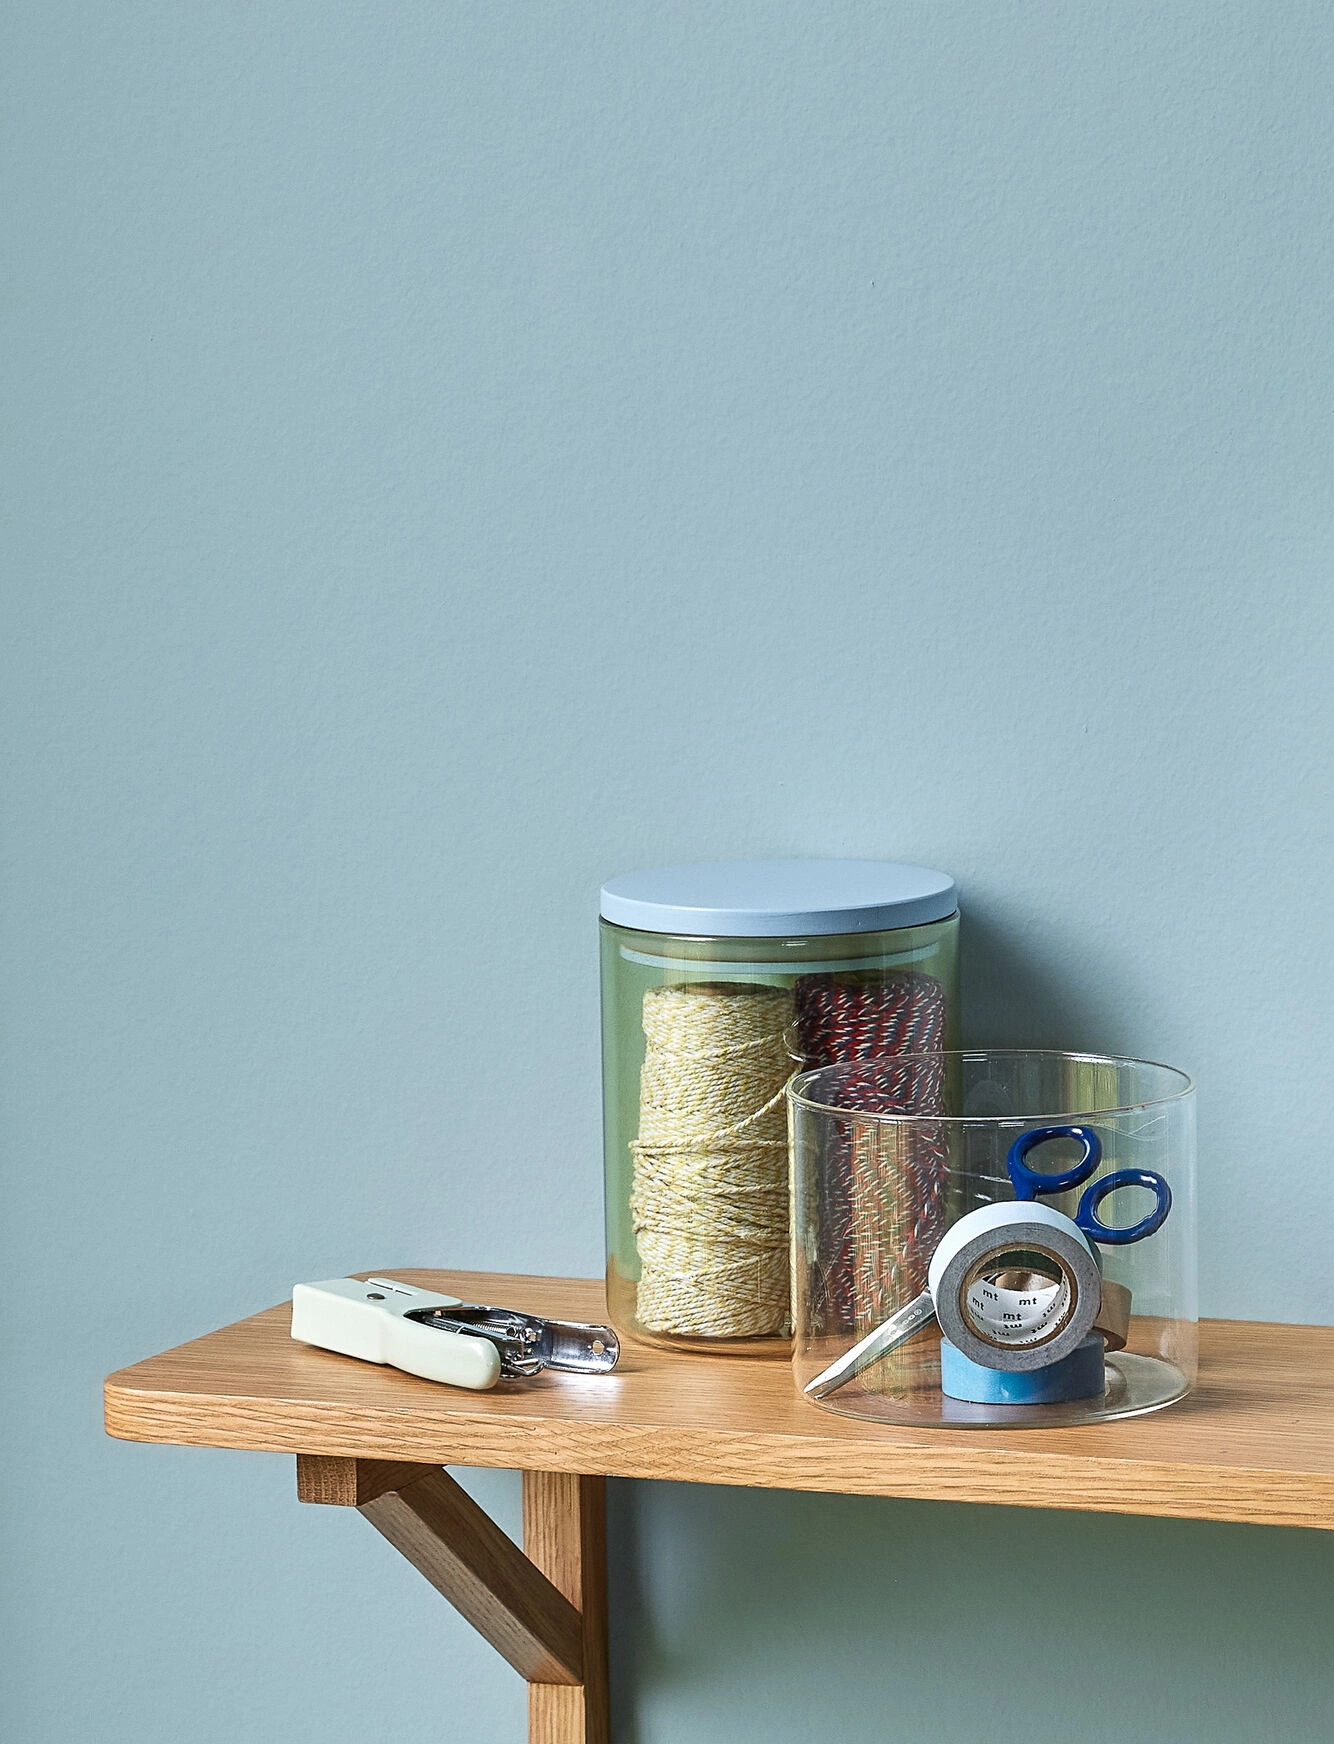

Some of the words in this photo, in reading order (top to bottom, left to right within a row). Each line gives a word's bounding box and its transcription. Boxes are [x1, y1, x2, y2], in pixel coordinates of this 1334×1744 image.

[982, 1288, 999, 1302] mt
[972, 1297, 985, 1311] mt
[1018, 1297, 1038, 1306] mt
[1003, 1312, 1022, 1321] mt
